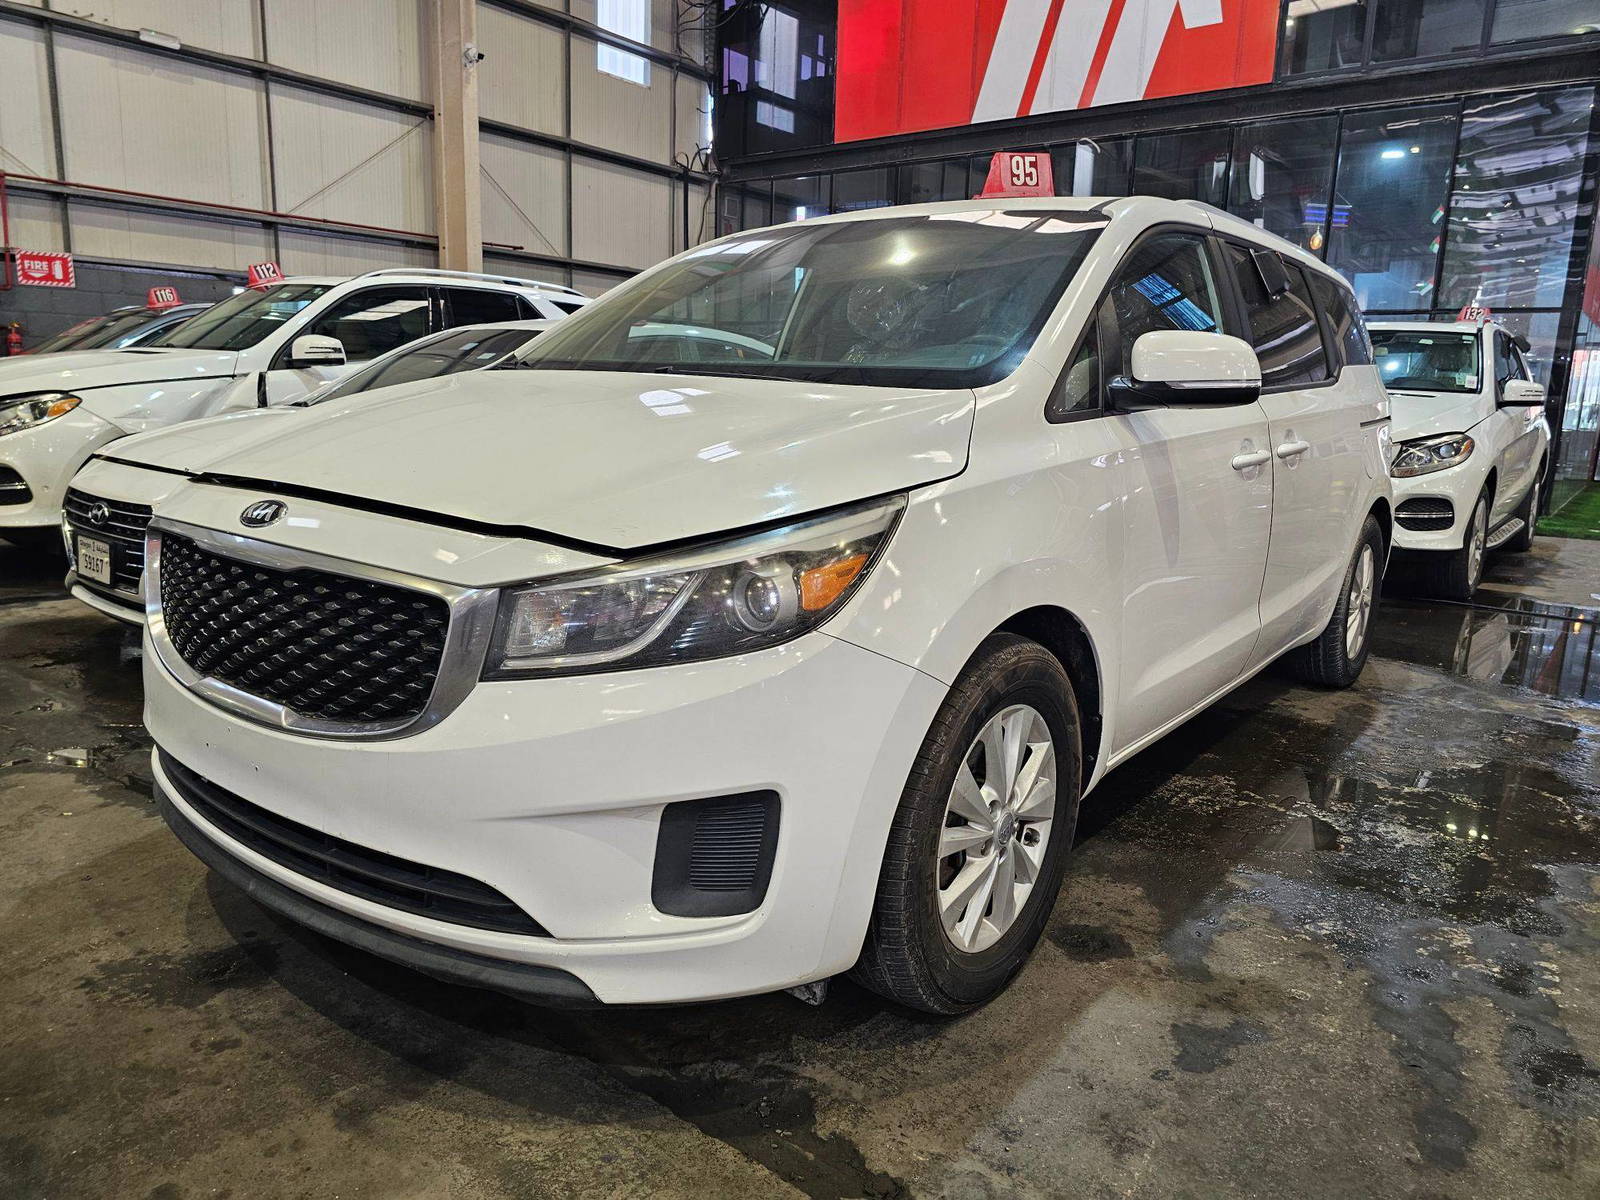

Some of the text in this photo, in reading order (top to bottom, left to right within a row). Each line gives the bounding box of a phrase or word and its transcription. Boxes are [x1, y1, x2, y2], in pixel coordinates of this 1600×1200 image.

[1011, 155, 1038, 186] 95
[24, 259, 49, 271] FIRE
[255, 263, 277, 279] 112
[155, 289, 174, 303] 116
[1465, 307, 1485, 320] 132
